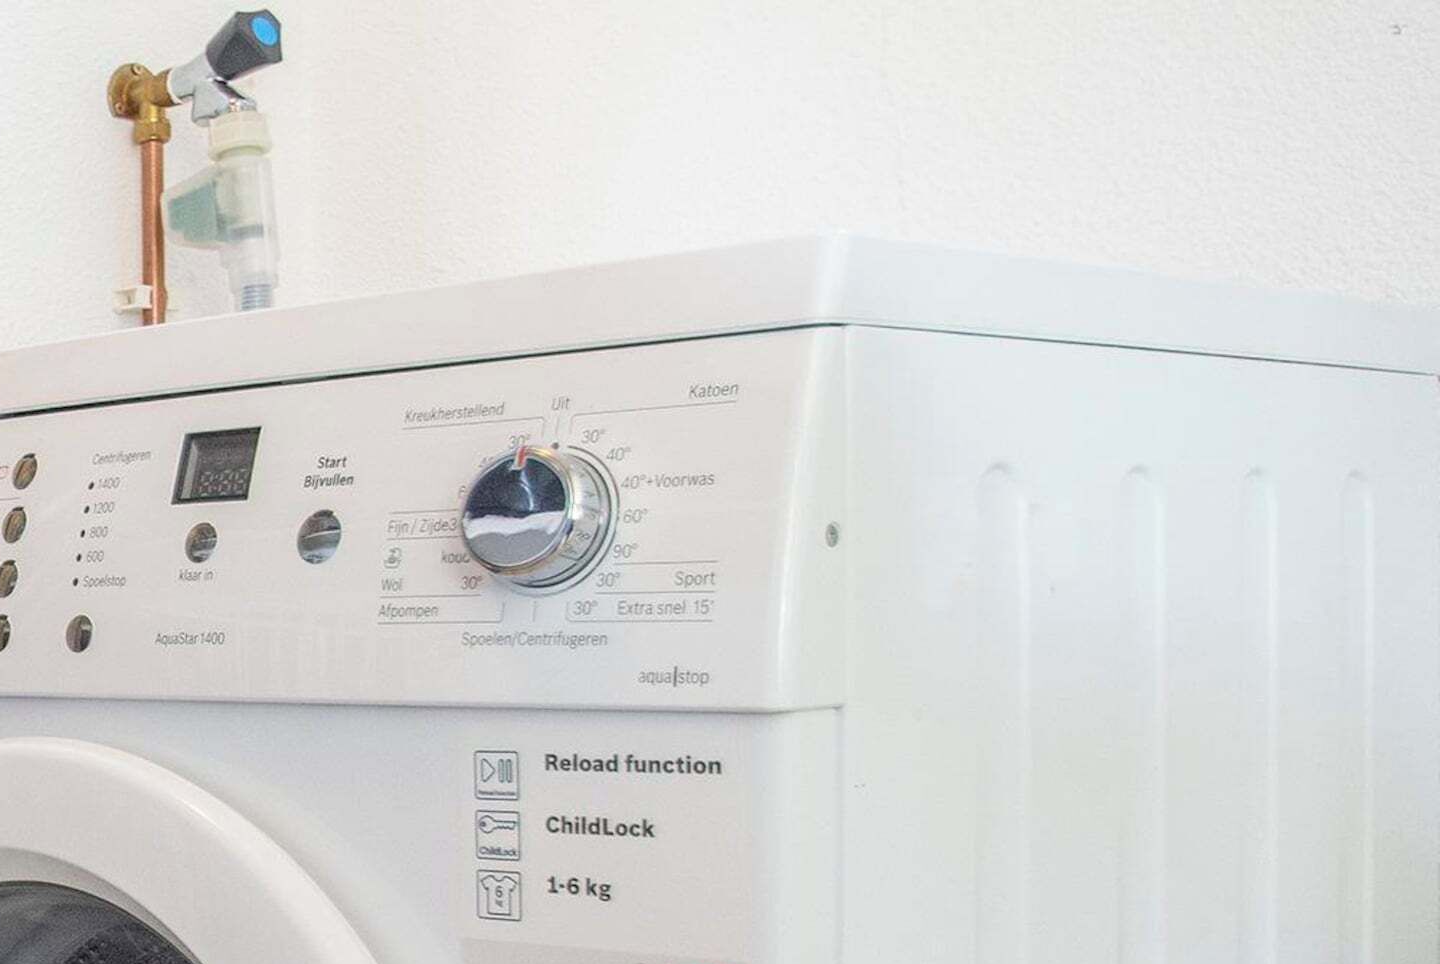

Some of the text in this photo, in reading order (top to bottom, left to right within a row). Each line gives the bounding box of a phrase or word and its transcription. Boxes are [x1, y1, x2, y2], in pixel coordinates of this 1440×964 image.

[688, 383, 739, 399] Katoen
[552, 397, 570, 411] Uit
[404, 402, 505, 423] Kreukherstellend
[581, 429, 606, 444] 30°
[92, 448, 152, 466] Centrifugeren
[606, 447, 631, 462] 40°
[317, 456, 348, 469] Start
[98, 477, 121, 491] 1400
[304, 474, 355, 490] Bijvullen
[92, 502, 115, 515] 1200
[623, 509, 648, 524] 60°
[88, 526, 109, 539] 800
[387, 519, 409, 537] Fijn
[85, 550, 105, 563] 600
[612, 543, 638, 559] 90°
[83, 574, 127, 590] Spoelstop
[178, 569, 214, 582] klaar in
[596, 571, 716, 588] 30° Sport
[381, 578, 403, 592] Wol
[460, 576, 483, 591] 30°
[378, 603, 439, 621] Afpompen
[573, 601, 598, 616] 30°
[617, 601, 653, 616] Extra
[656, 600, 686, 616] snel
[155, 632, 226, 647] AquaStar 1400
[461, 631, 608, 649] Spoelen/Centrifugeren
[544, 753, 723, 775] Reload function
[546, 816, 656, 838] ChildLock
[479, 846, 518, 857] ChildLock
[547, 876, 612, 902] 1-6 kg
